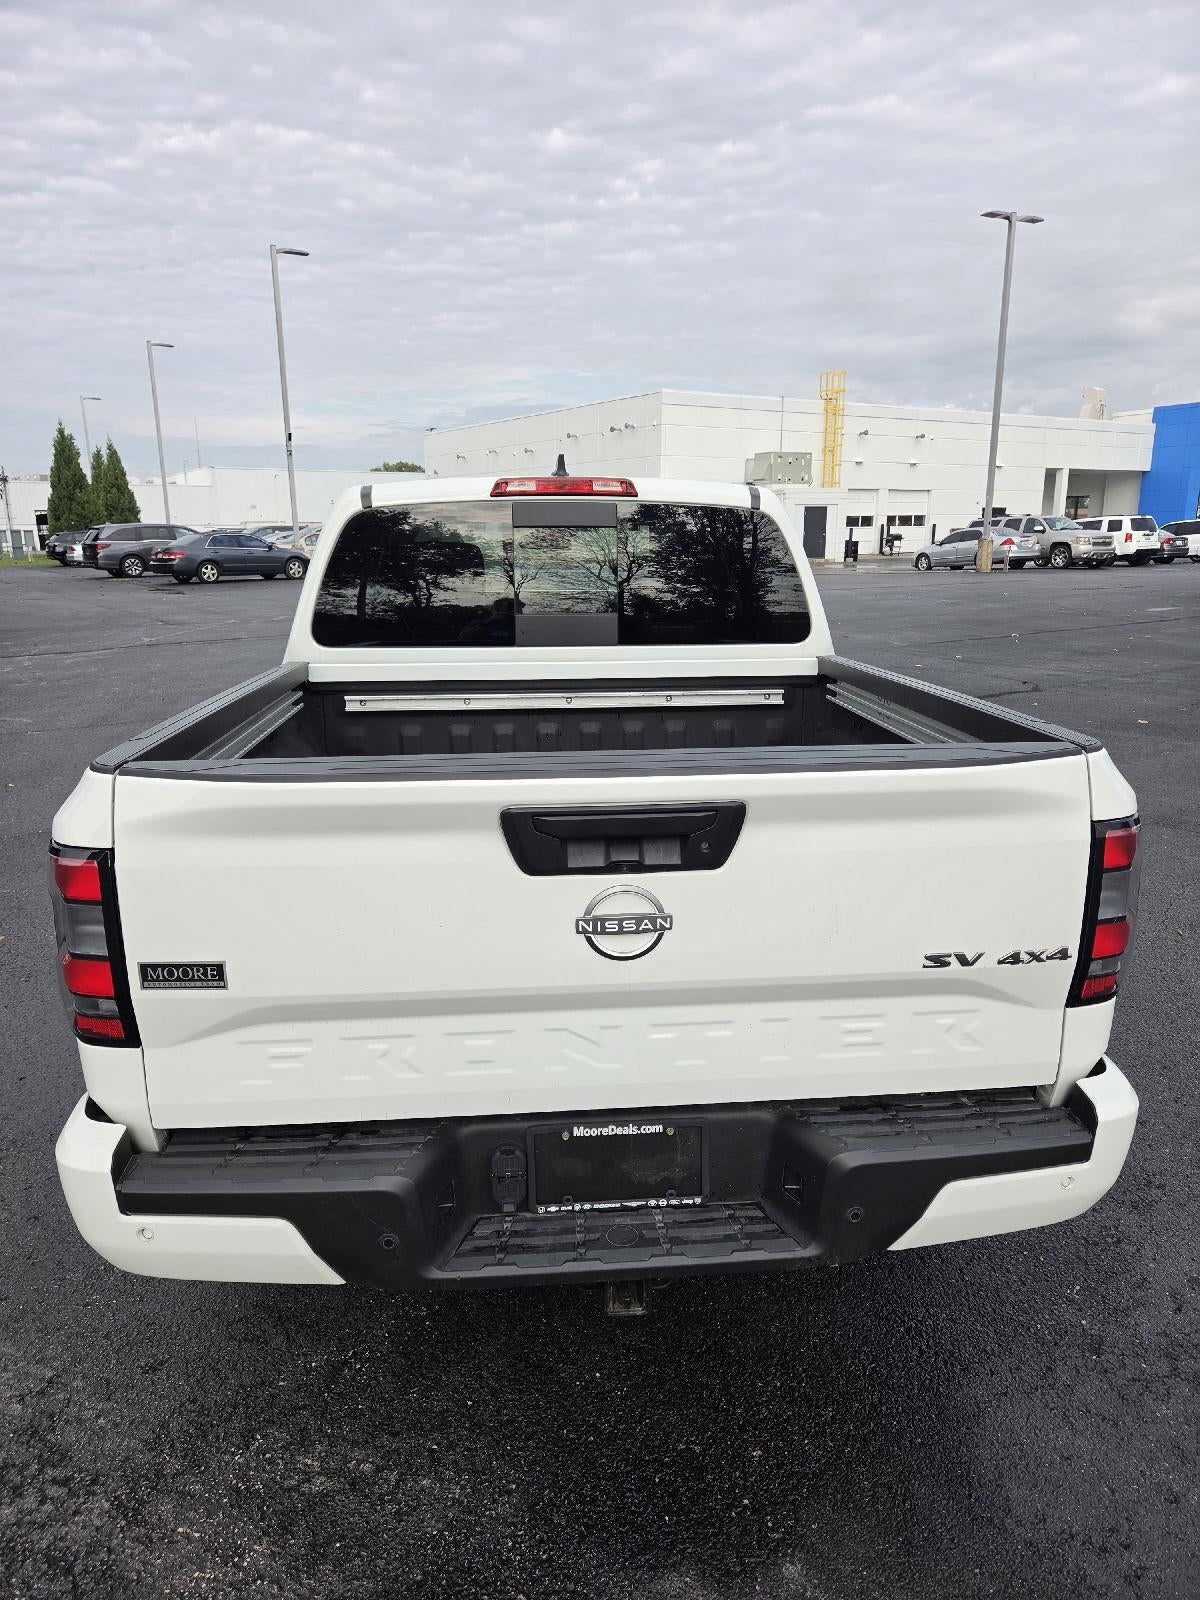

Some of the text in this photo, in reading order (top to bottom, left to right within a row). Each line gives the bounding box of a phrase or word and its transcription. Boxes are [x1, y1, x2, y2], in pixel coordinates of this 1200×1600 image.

[578, 917, 671, 932] NISSAN
[922, 951, 986, 969] SV
[146, 966, 219, 980] MOORE
[572, 1123, 664, 1137] MooreDeals.com
